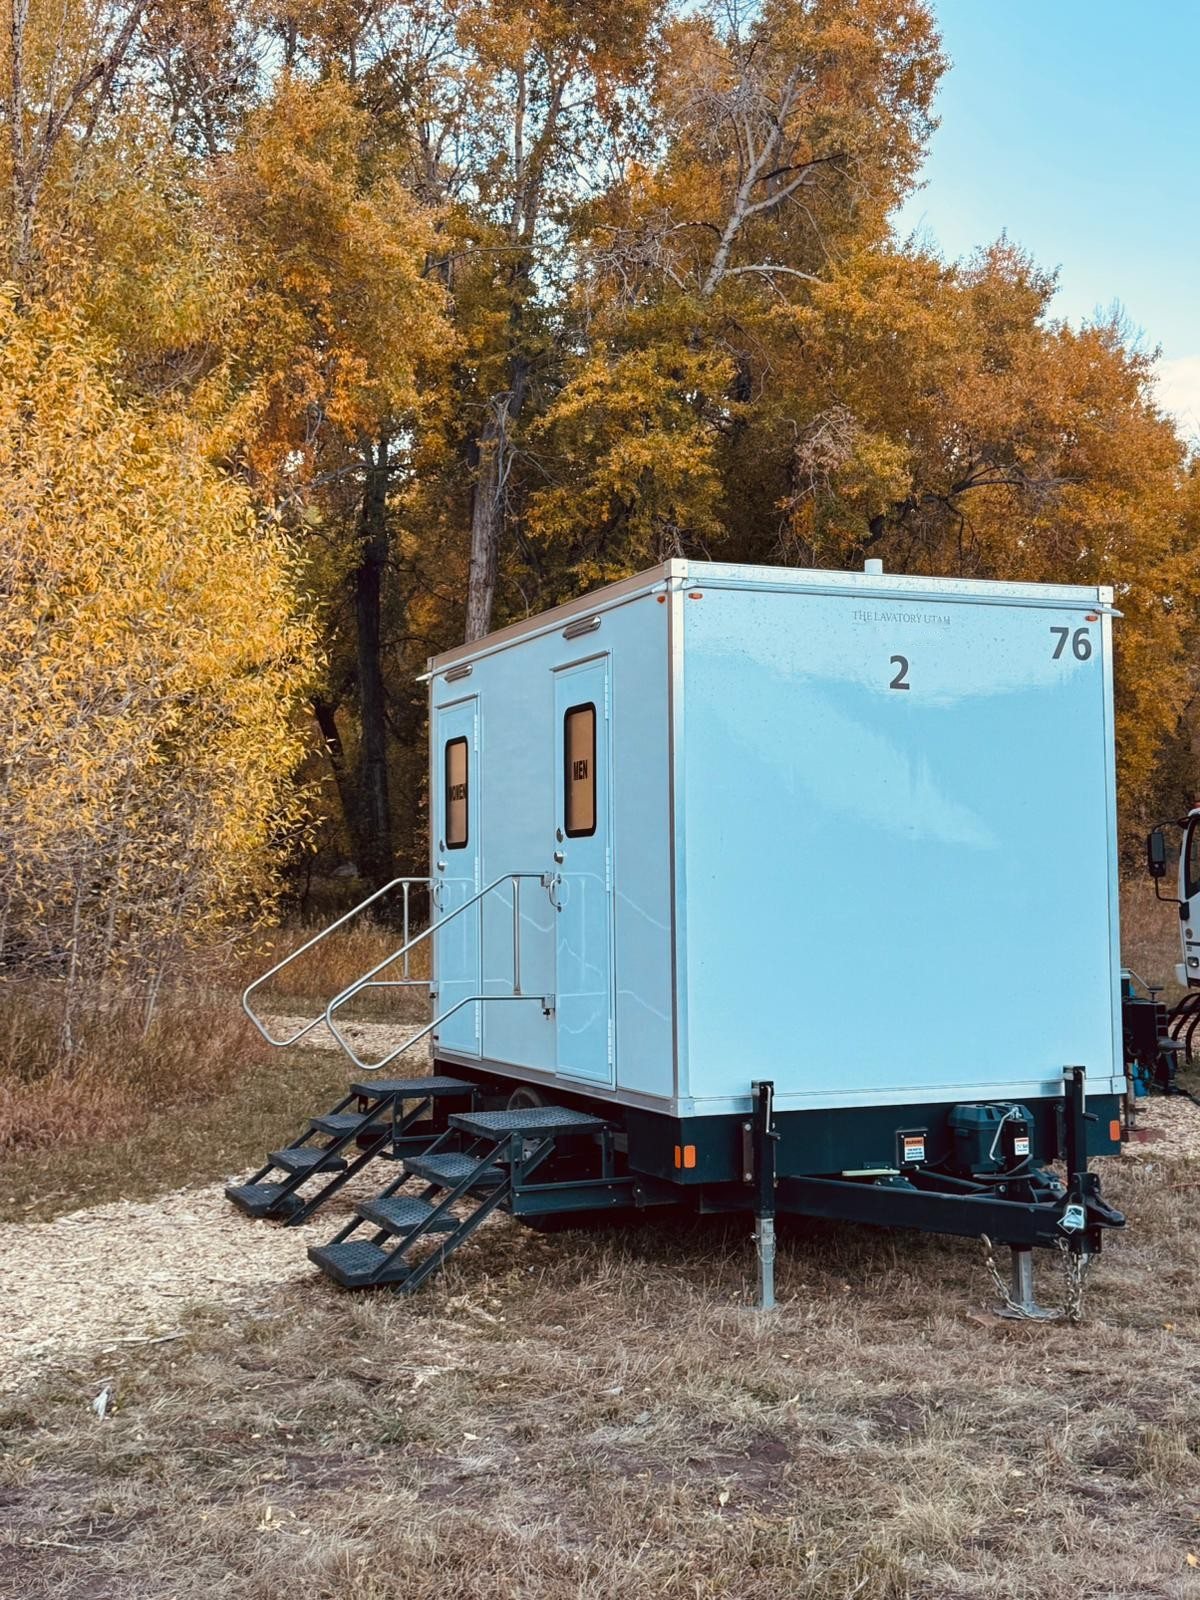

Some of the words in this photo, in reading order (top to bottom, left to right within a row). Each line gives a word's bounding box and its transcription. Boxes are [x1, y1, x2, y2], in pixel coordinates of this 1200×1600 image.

[852, 610, 873, 622] THE
[874, 611, 922, 624] LAVATORY
[924, 615, 951, 625] UTAH
[1049, 626, 1092, 661] 76
[889, 655, 910, 690] 2
[573, 759, 588, 781] MEN
